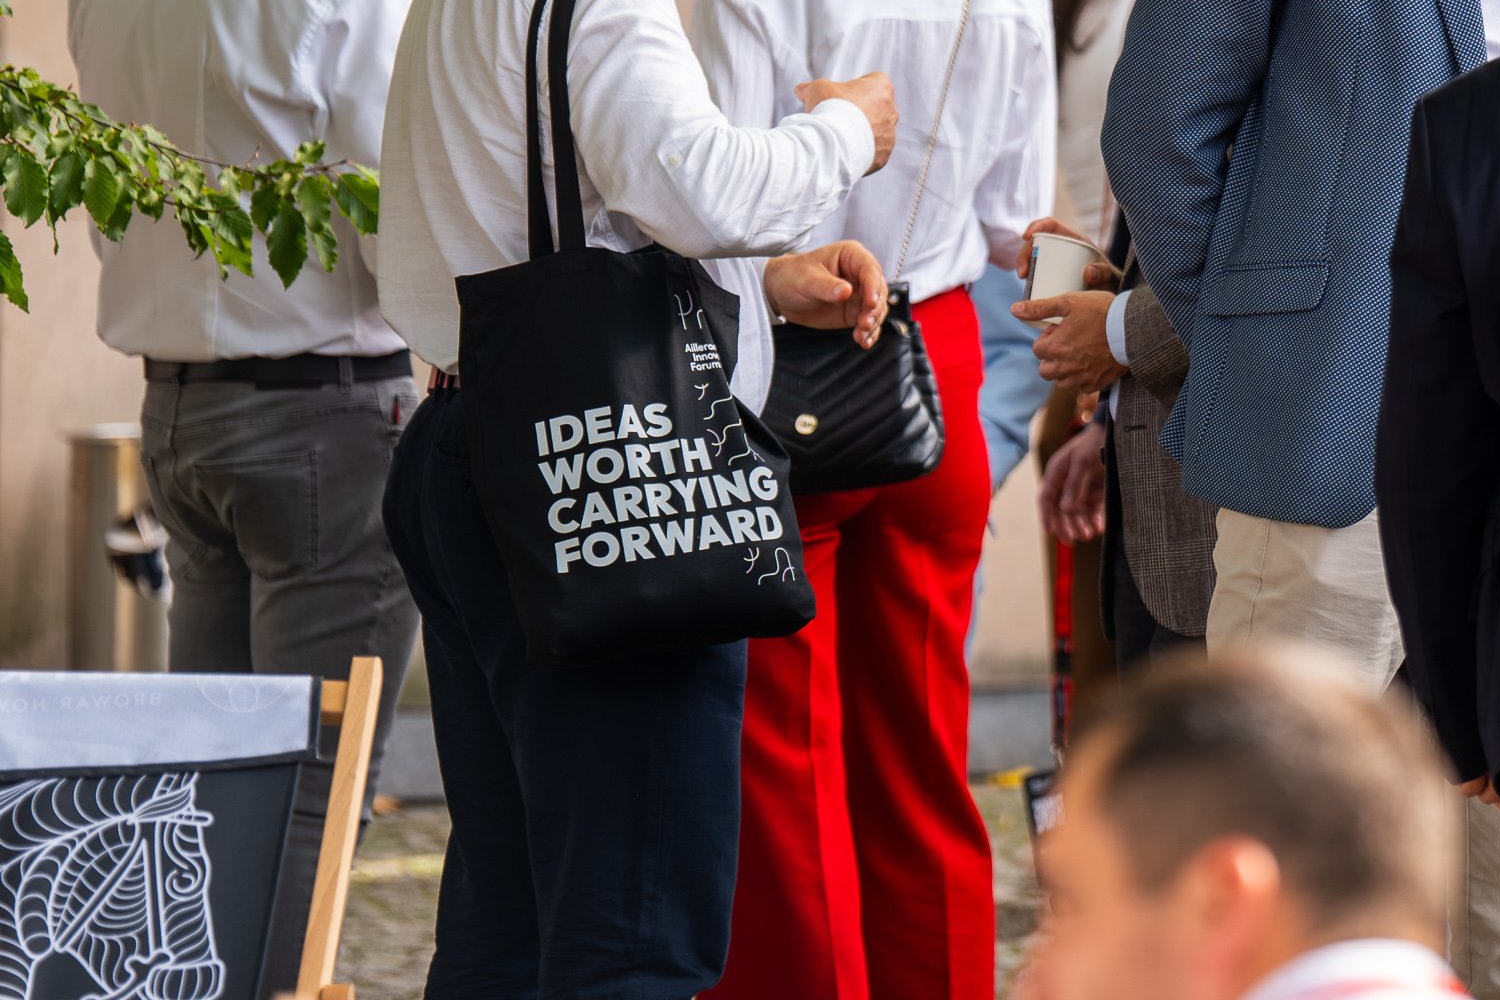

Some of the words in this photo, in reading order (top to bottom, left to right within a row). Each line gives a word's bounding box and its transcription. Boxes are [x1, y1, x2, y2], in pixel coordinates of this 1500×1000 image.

[690, 361, 722, 372] Forum
[692, 352, 720, 362] Innov
[535, 402, 673, 456] IDEAS
[538, 437, 713, 494] WORTH
[547, 466, 779, 534] CARRYING
[554, 506, 783, 574] FORWARD
